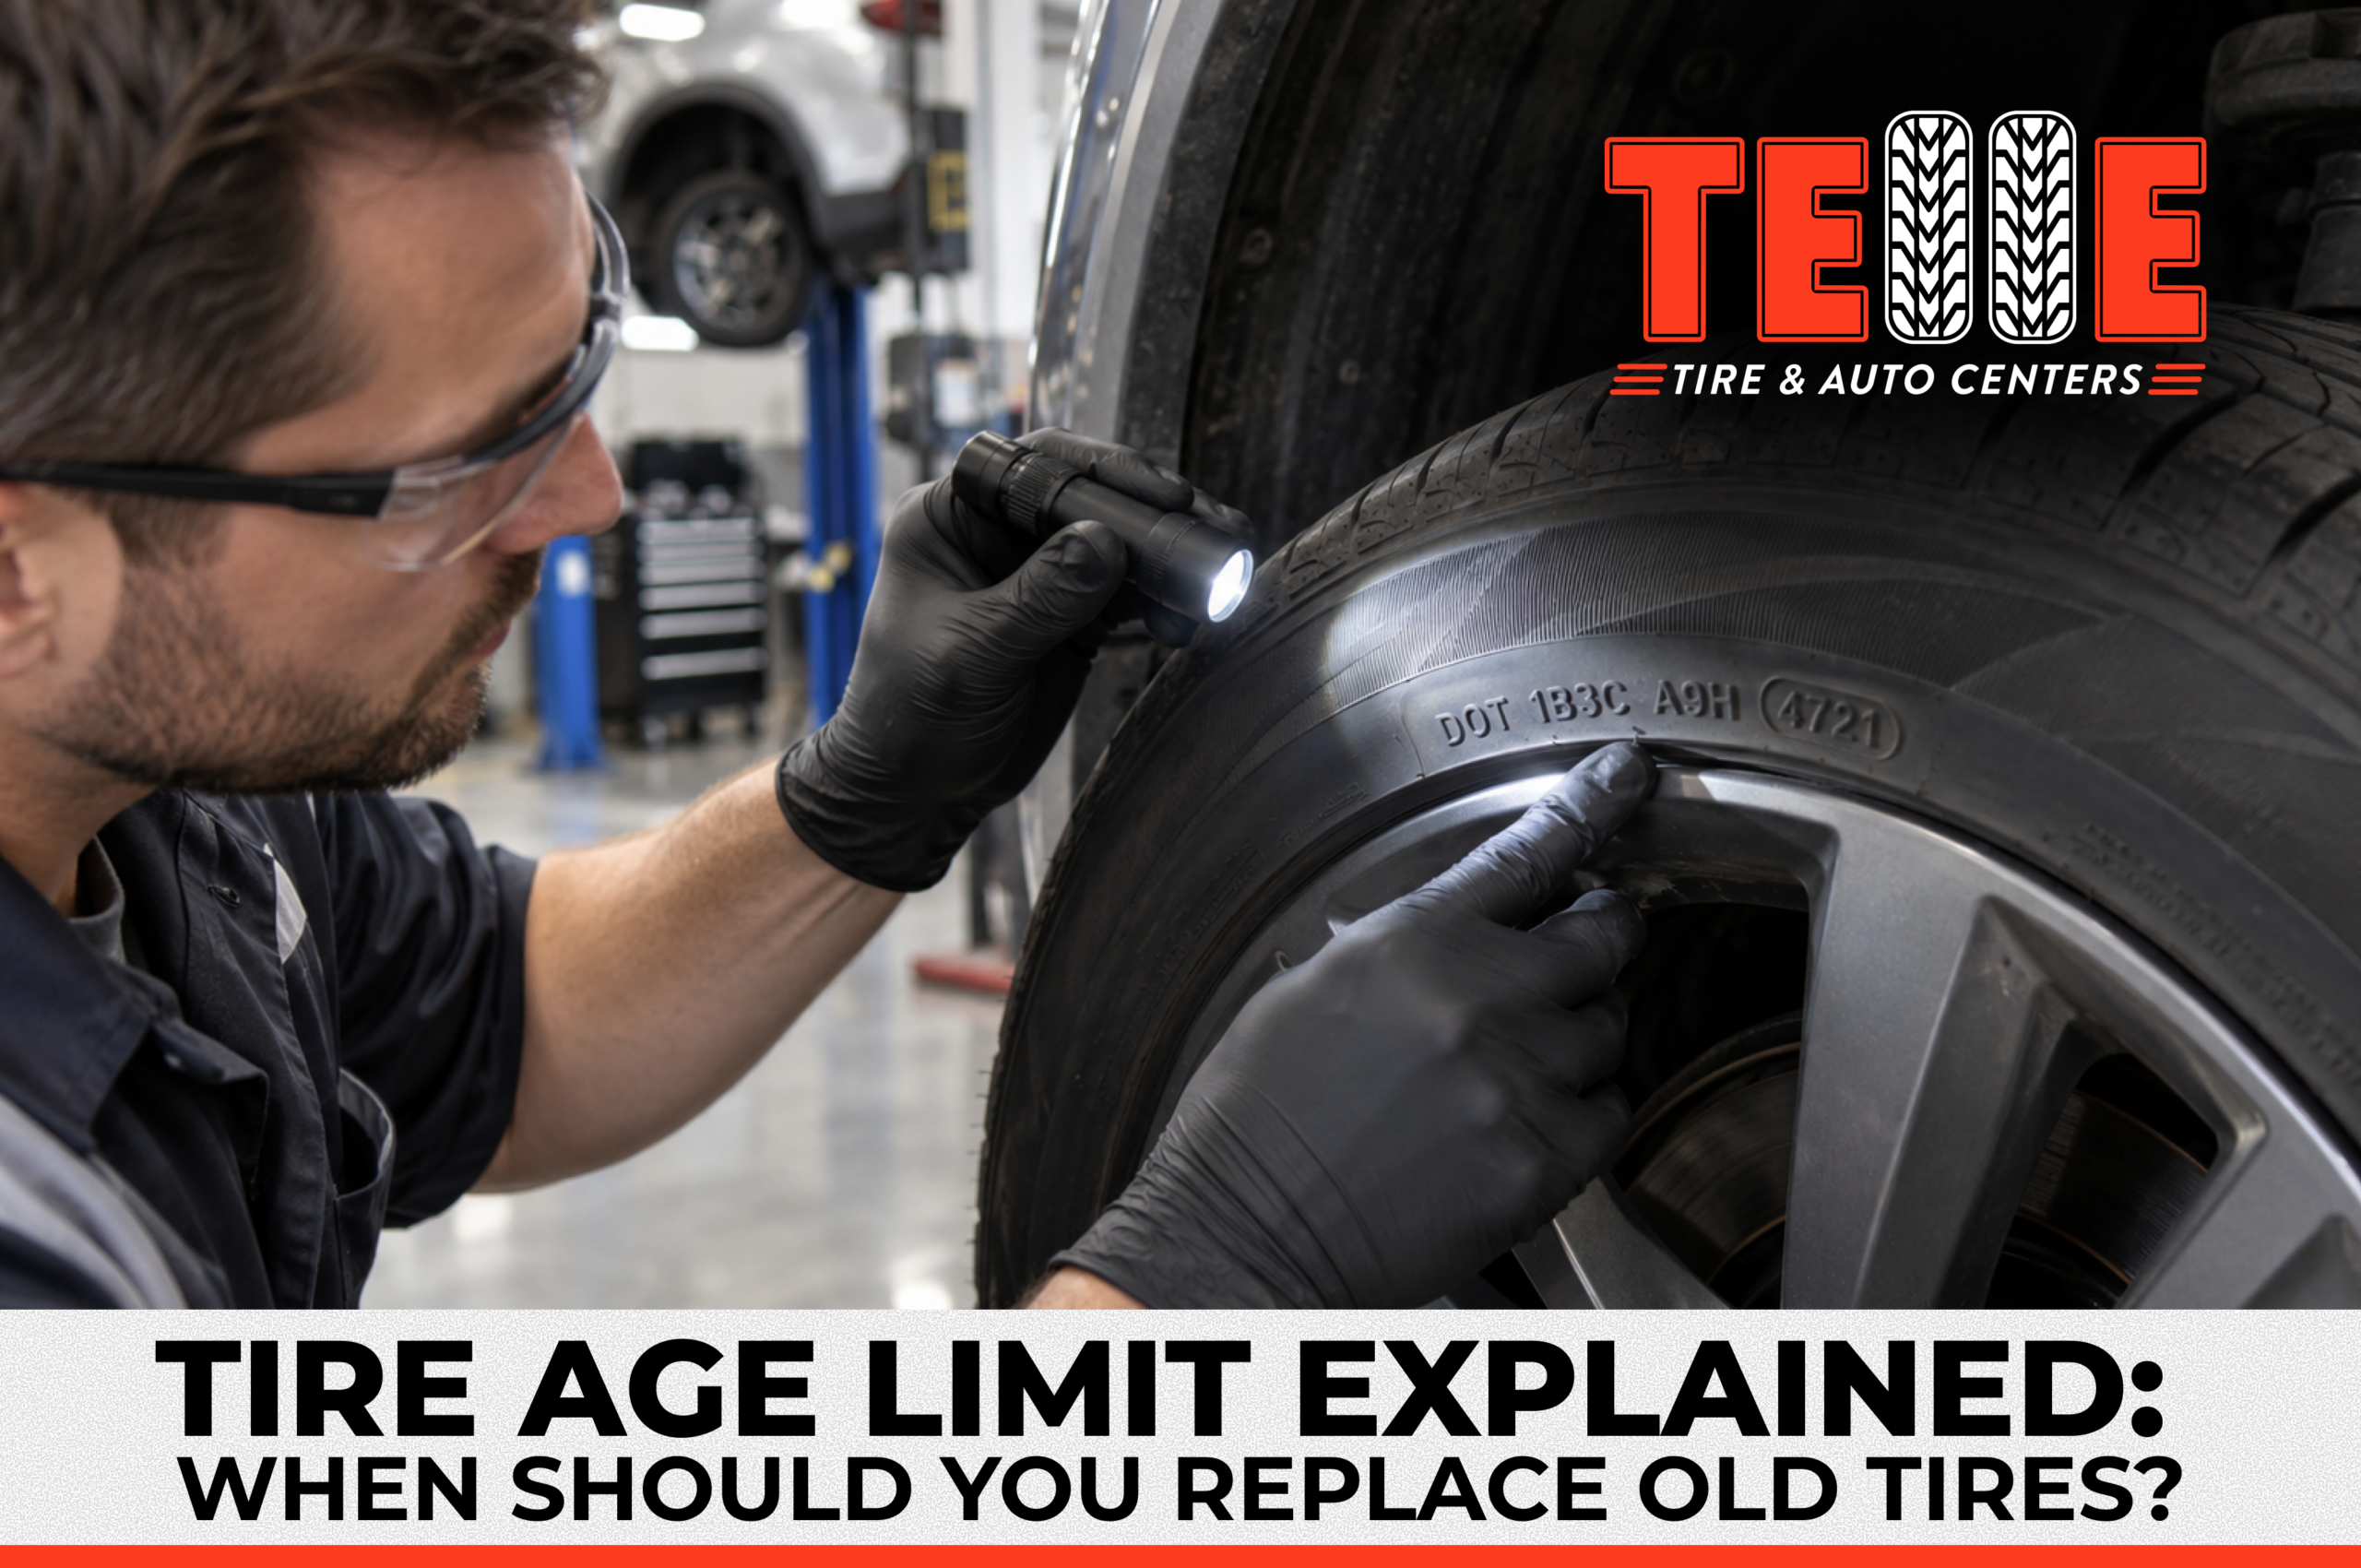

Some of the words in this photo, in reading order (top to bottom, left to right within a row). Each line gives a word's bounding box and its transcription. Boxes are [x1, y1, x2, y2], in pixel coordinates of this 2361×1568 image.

[1435, 695, 1511, 747] DOT
[1529, 679, 1631, 725] 1B3C
[1653, 679, 1741, 721] A9H
[1777, 690, 1881, 749] 4721
